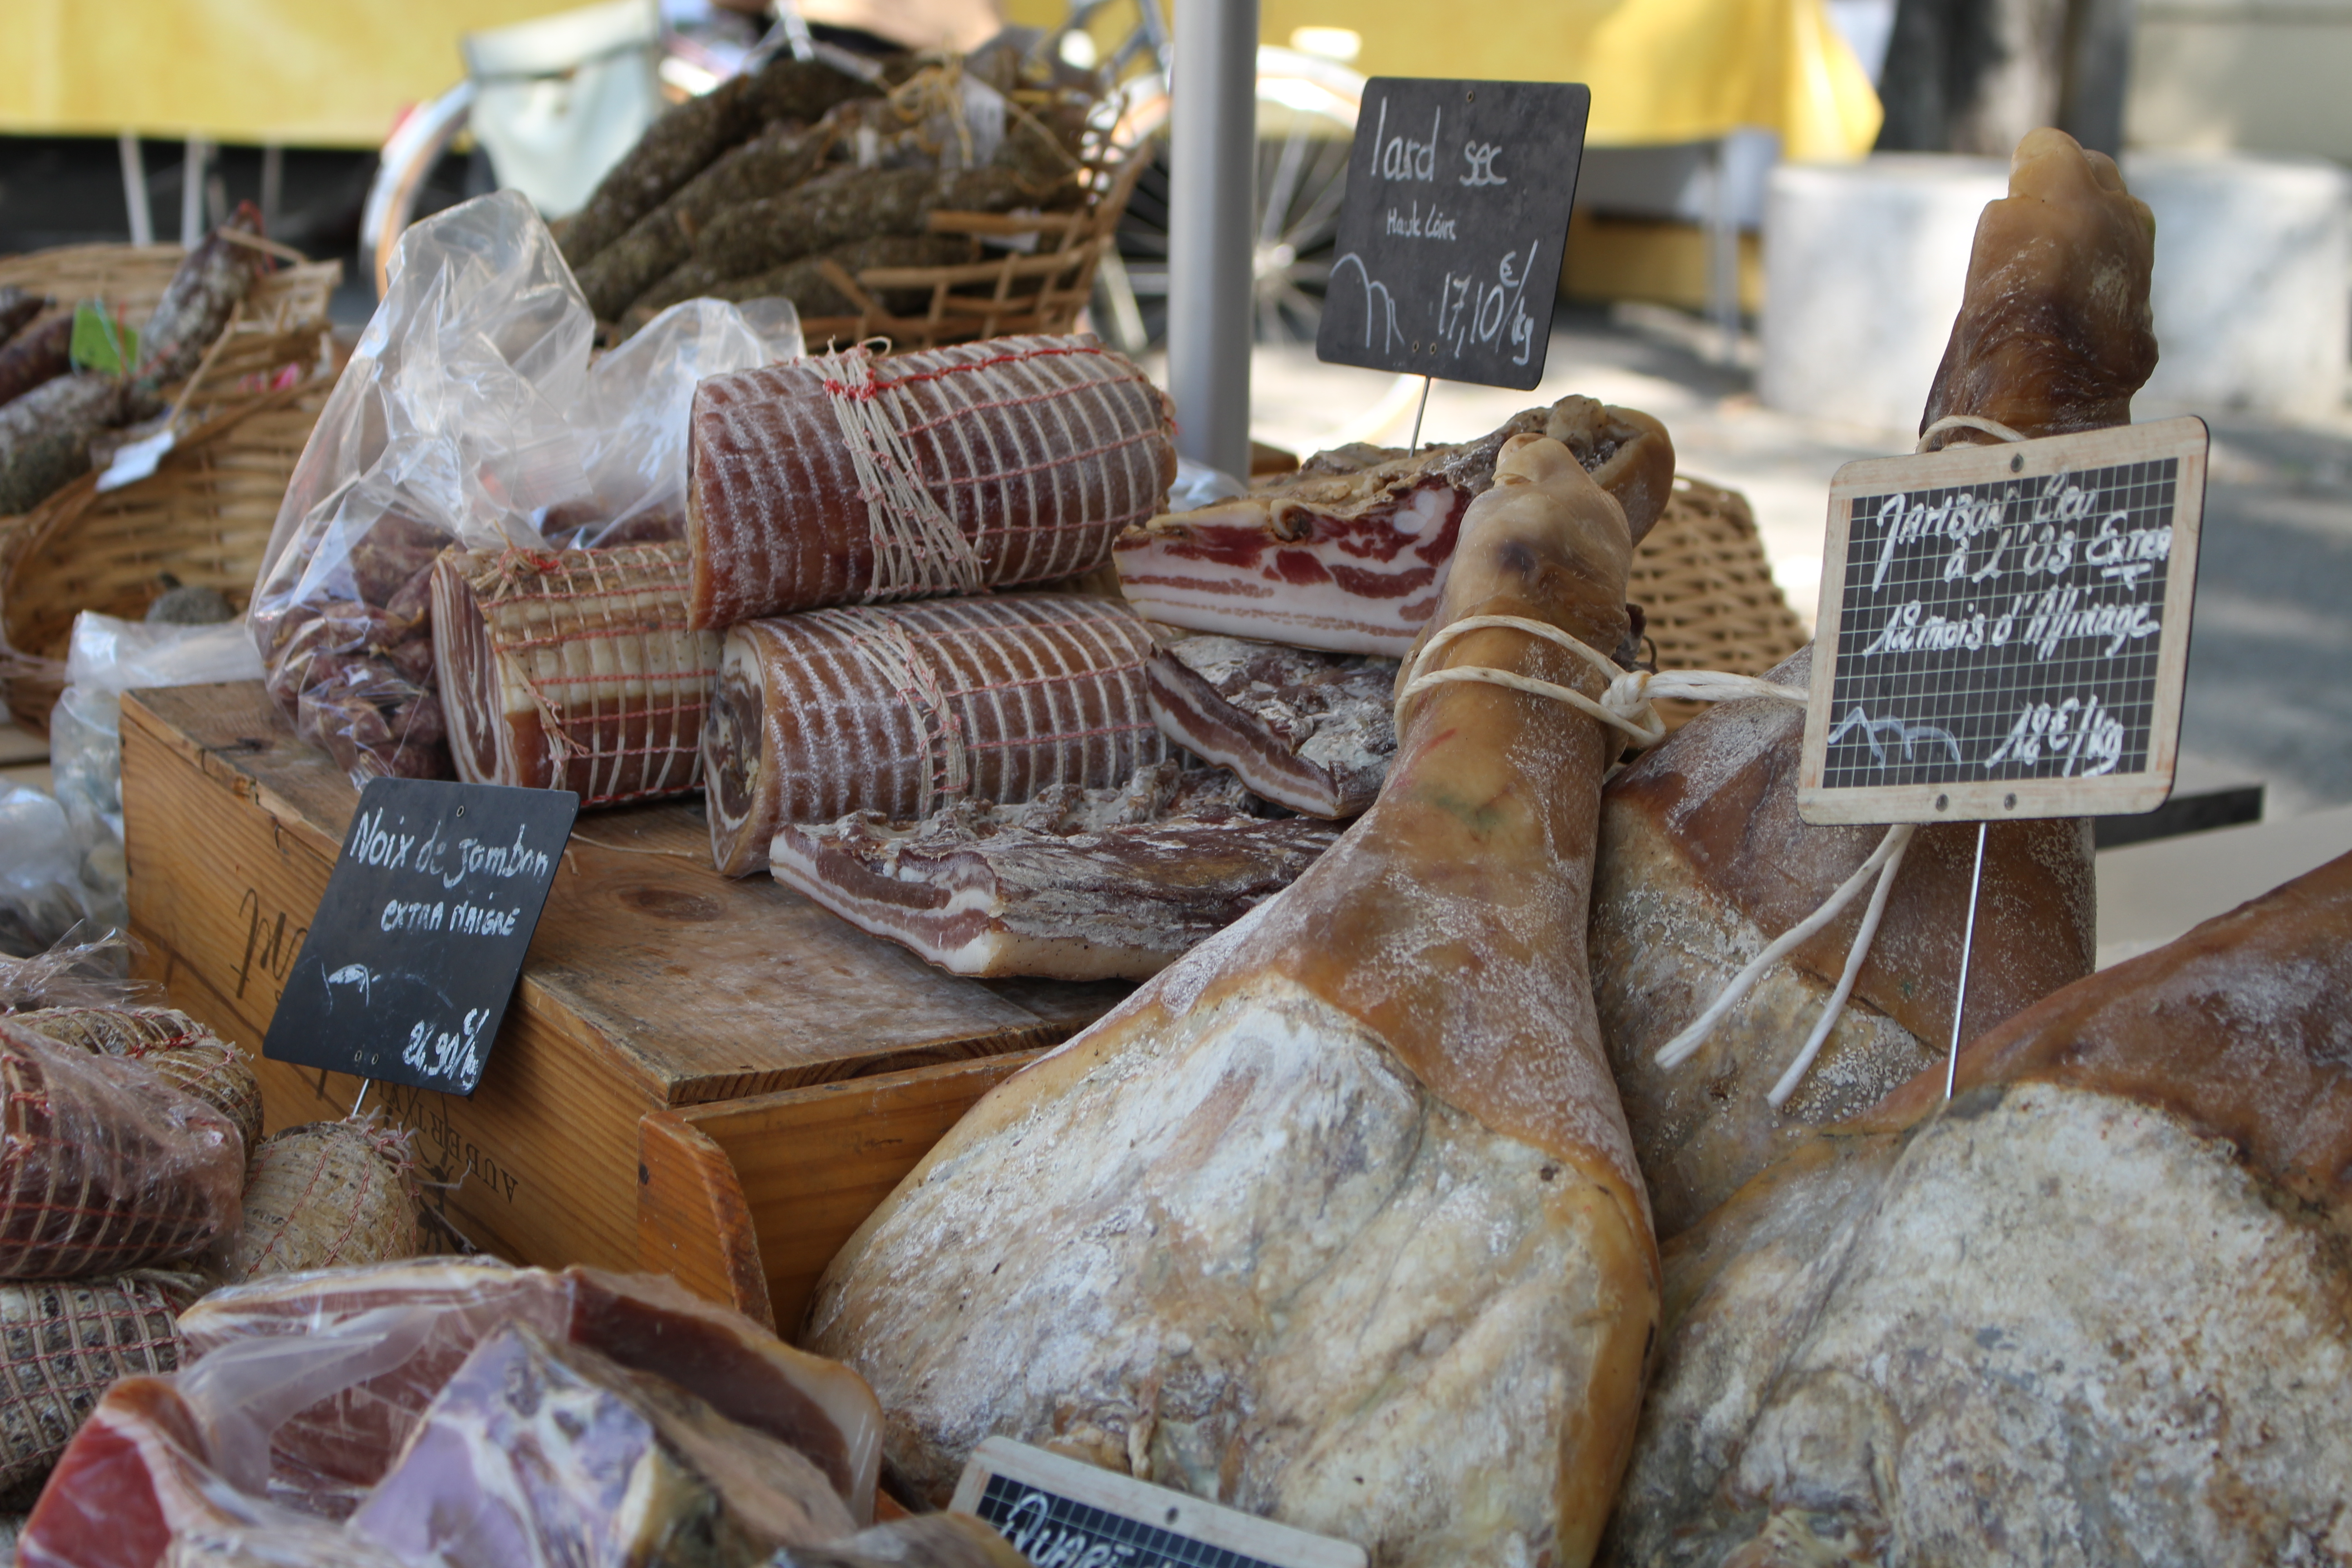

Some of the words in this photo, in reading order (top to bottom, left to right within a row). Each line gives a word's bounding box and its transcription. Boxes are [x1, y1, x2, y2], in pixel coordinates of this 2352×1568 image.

[1371, 96, 1441, 182] lard
[1459, 140, 1508, 187] sec
[349, 806, 415, 870] Noix
[415, 819, 447, 875] de
